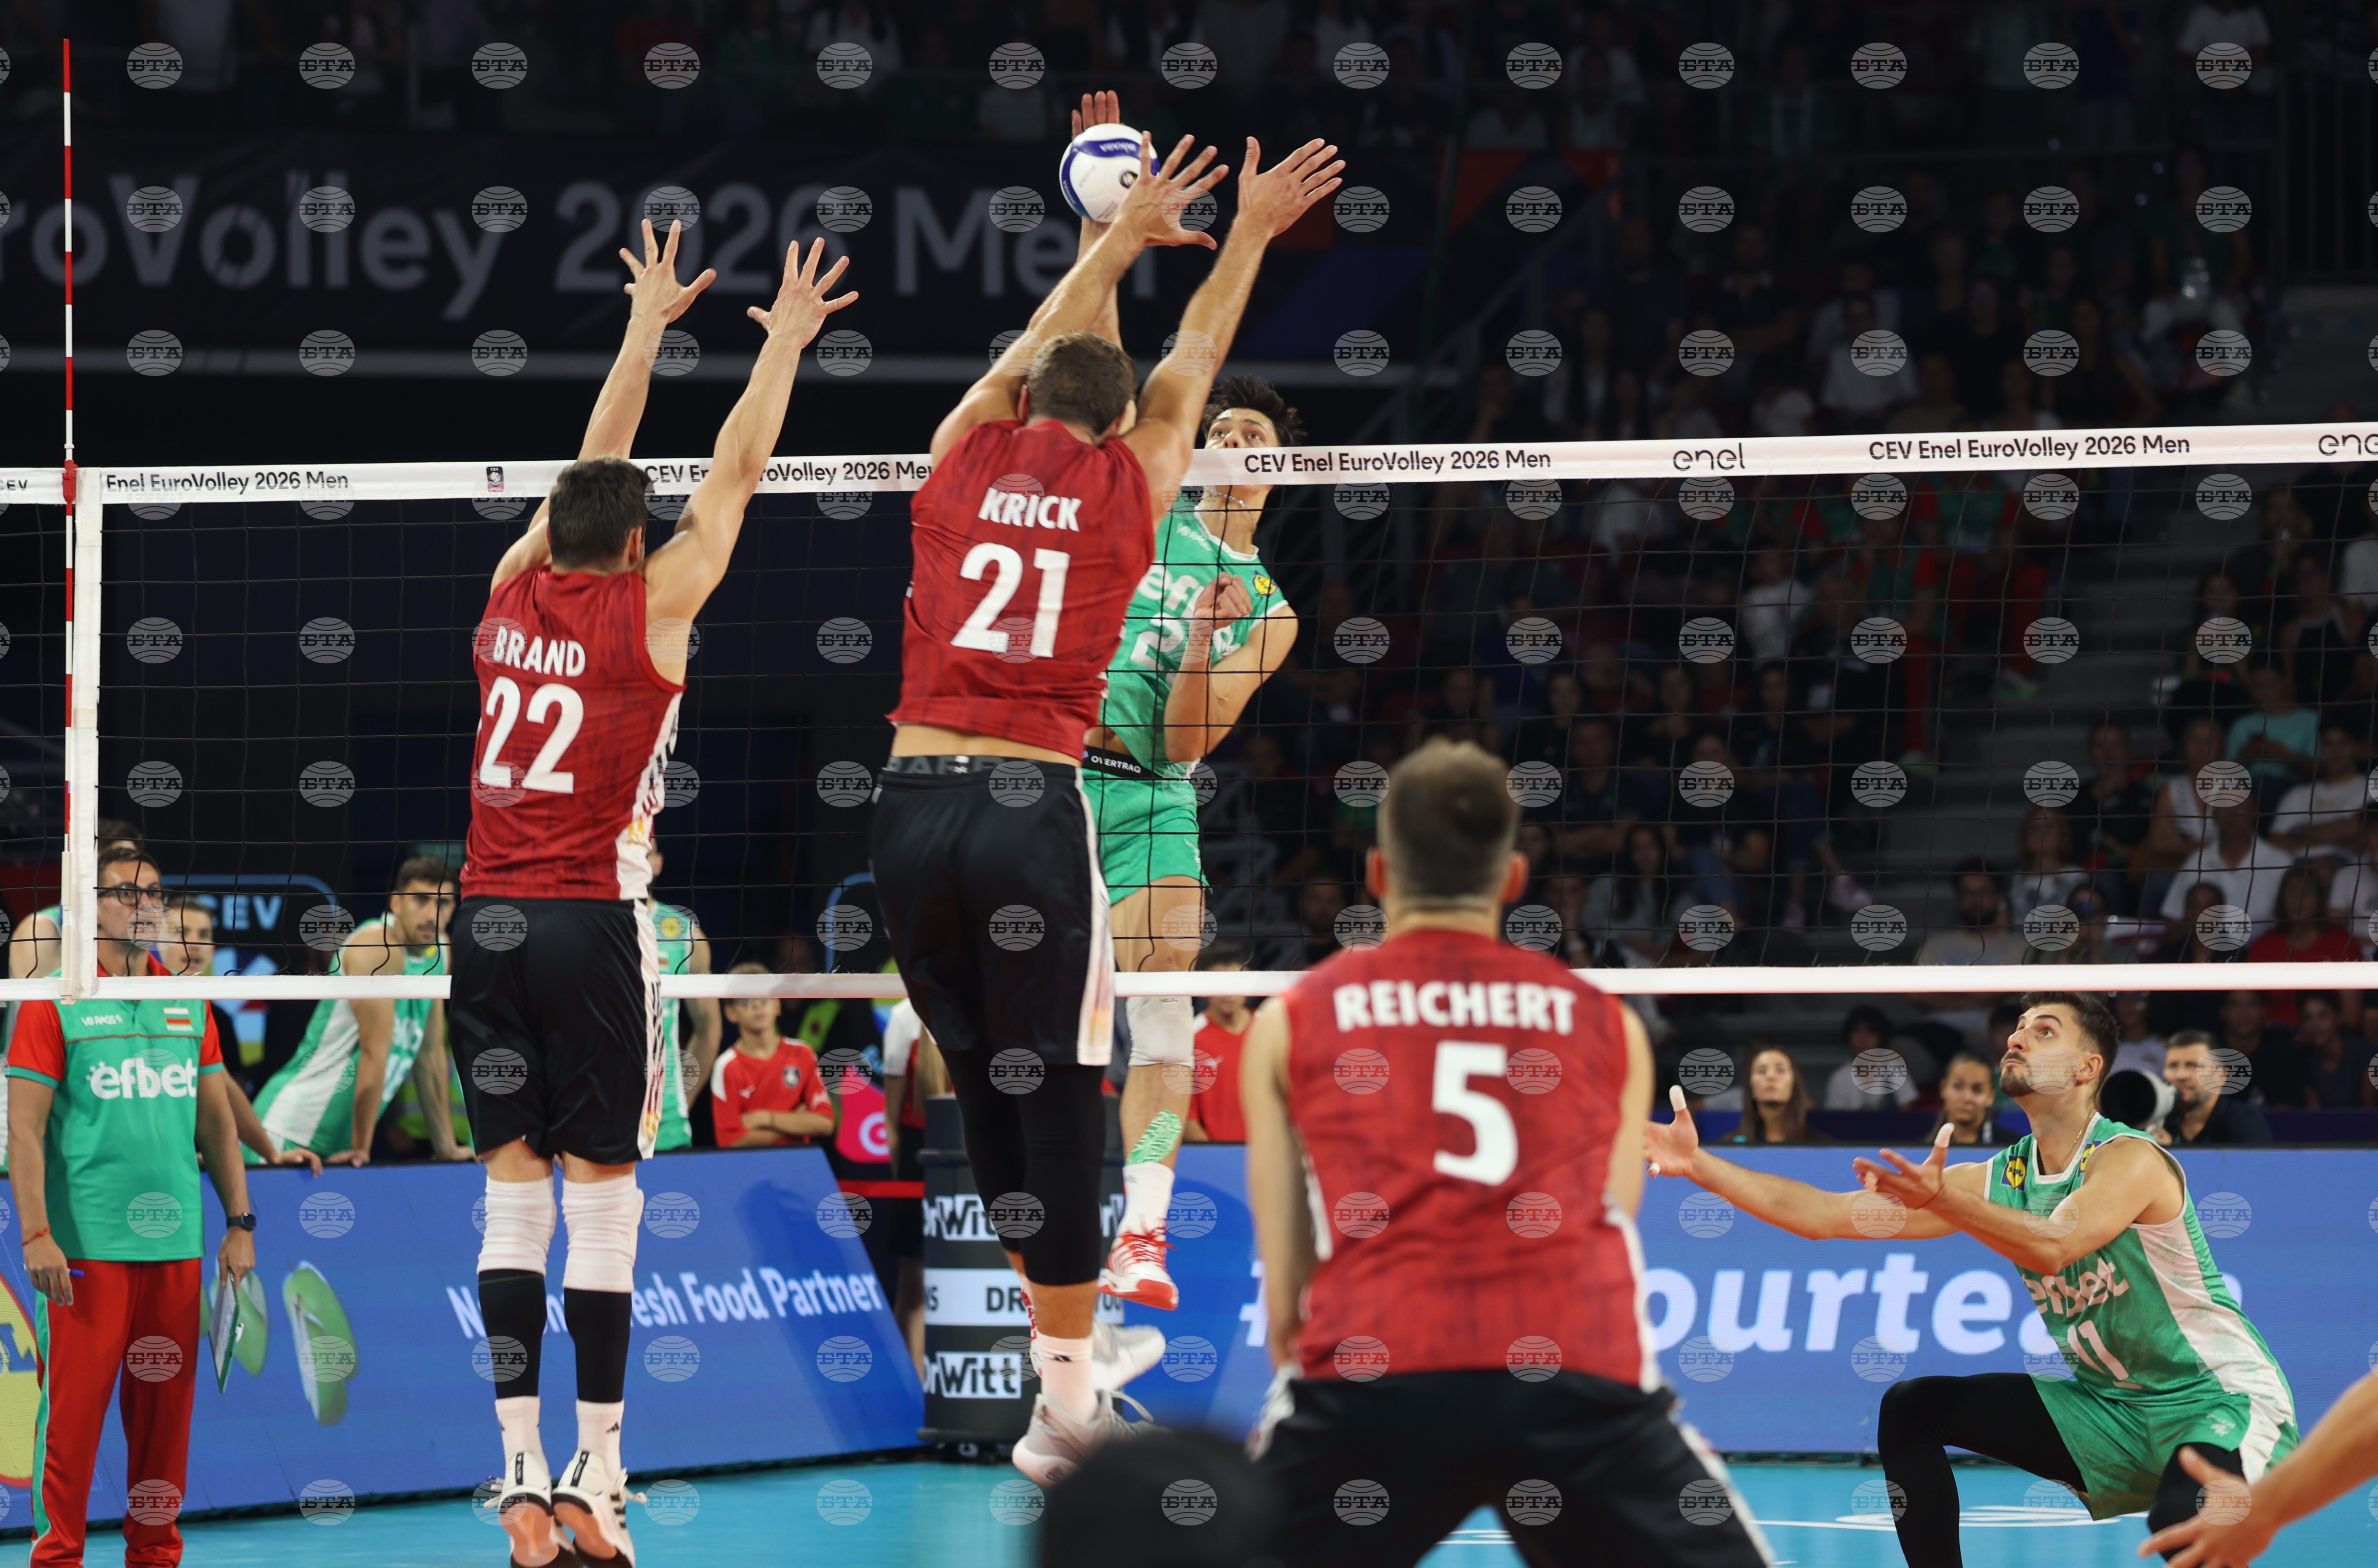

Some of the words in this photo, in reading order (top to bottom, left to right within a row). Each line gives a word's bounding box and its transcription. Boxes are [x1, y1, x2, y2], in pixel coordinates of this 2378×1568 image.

[645, 465, 683, 483] CEV
[690, 465, 710, 482] En
[842, 461, 890, 480] 2026
[1244, 454, 1286, 473] CEV
[1292, 452, 1333, 472] Enel
[1339, 451, 1444, 474] EuroVolley
[1451, 450, 1499, 469] 2026
[1506, 450, 1550, 468] Men
[1673, 443, 1745, 471] enel
[1870, 441, 1912, 460] CEV
[1919, 439, 1961, 459] Enel
[1968, 437, 2078, 460] EuroVolley
[2085, 435, 2136, 455] 2026
[2143, 435, 2189, 454] Men
[106, 473, 145, 492] Enel
[150, 472, 249, 495] EuroVolley
[255, 471, 300, 489] 2026
[307, 471, 348, 489] Men
[978, 487, 1083, 532] KRICK
[950, 542, 1070, 658] 21
[493, 625, 586, 678] BRAND
[479, 675, 584, 794] 22
[1333, 979, 1577, 1036] REICHERT
[90, 1057, 197, 1100] efbet
[1432, 1041, 1519, 1186] 5
[679, 1267, 769, 1323] Food
[758, 1267, 883, 1318] Partner
[2026, 1257, 2130, 1318] efbet
[2067, 1319, 2129, 1381] 11
